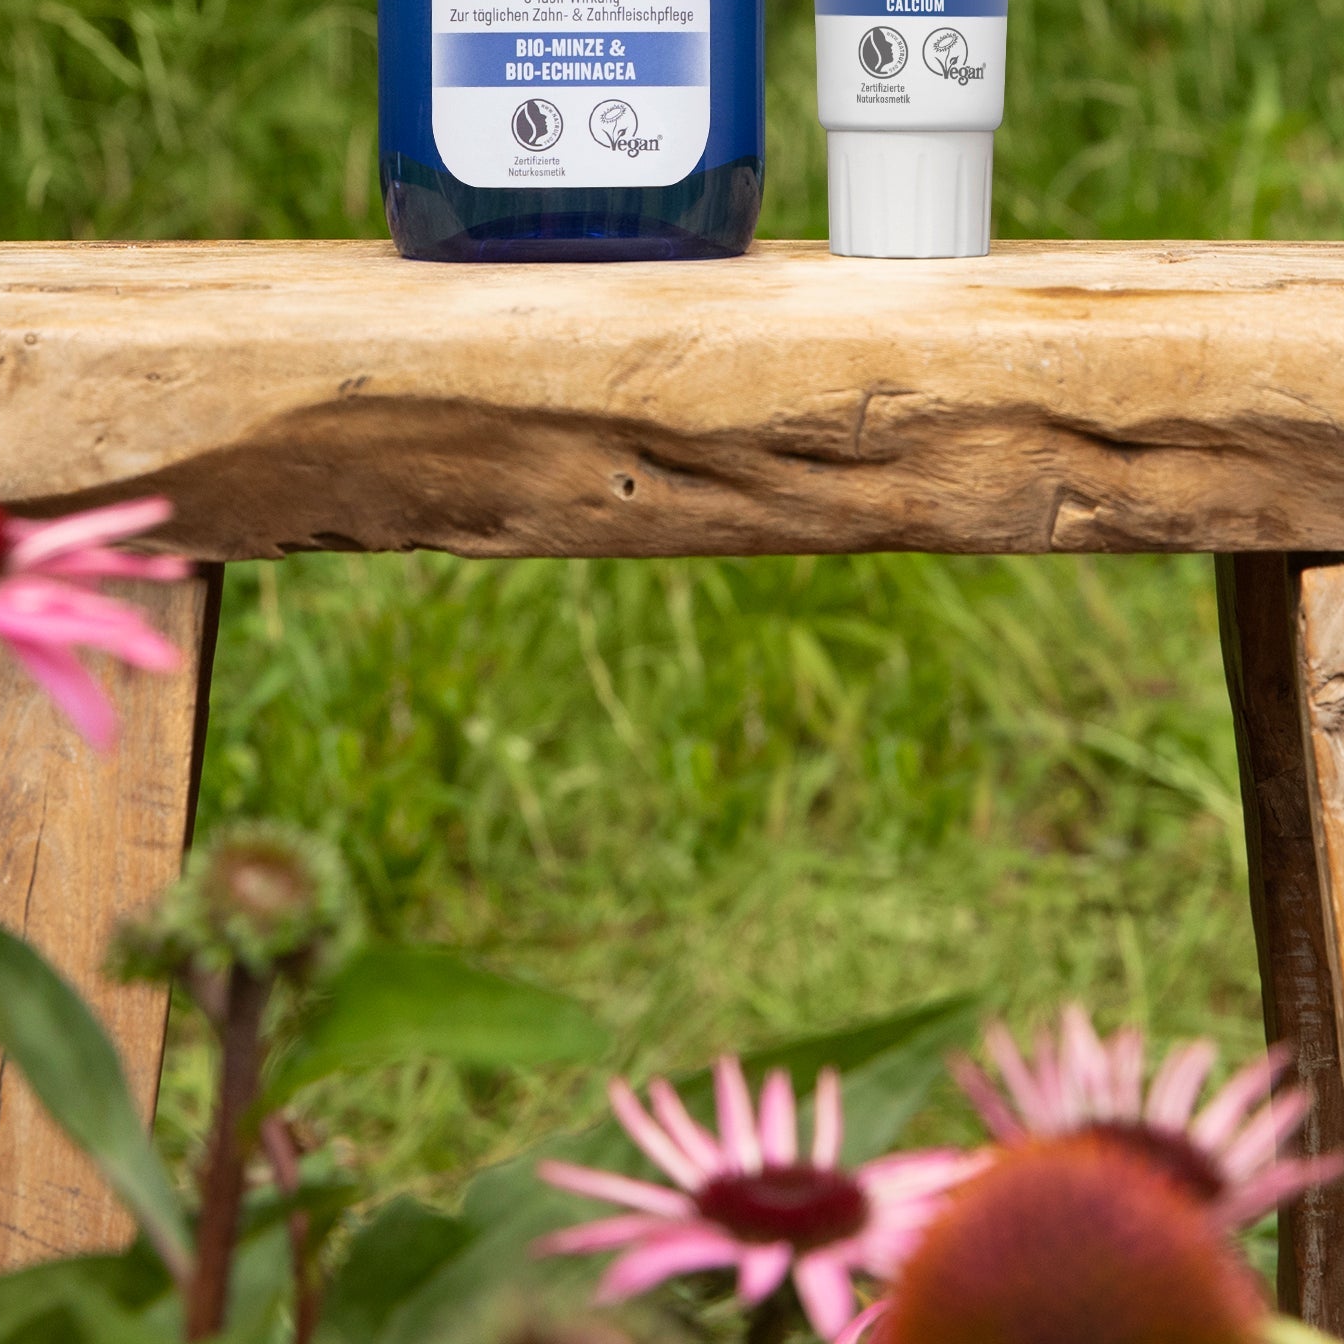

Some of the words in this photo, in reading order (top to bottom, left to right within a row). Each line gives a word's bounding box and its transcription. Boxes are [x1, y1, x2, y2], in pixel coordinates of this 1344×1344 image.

[450, 9, 469, 22] Zur
[472, 7, 529, 26] täglichen
[533, 7, 569, 22] Zahn-
[572, 8, 583, 22] &
[587, 6, 694, 25] Zahnfleischpflege
[516, 38, 605, 57] BIO-MINZE
[609, 39, 626, 57] &
[506, 62, 636, 81] BIO-ECHINACEA
[861, 83, 905, 93] Zertifizierte
[856, 94, 911, 104] Naturkosmetik
[514, 156, 560, 166] Zertifizierte
[508, 167, 566, 177] Naturkosmetik
